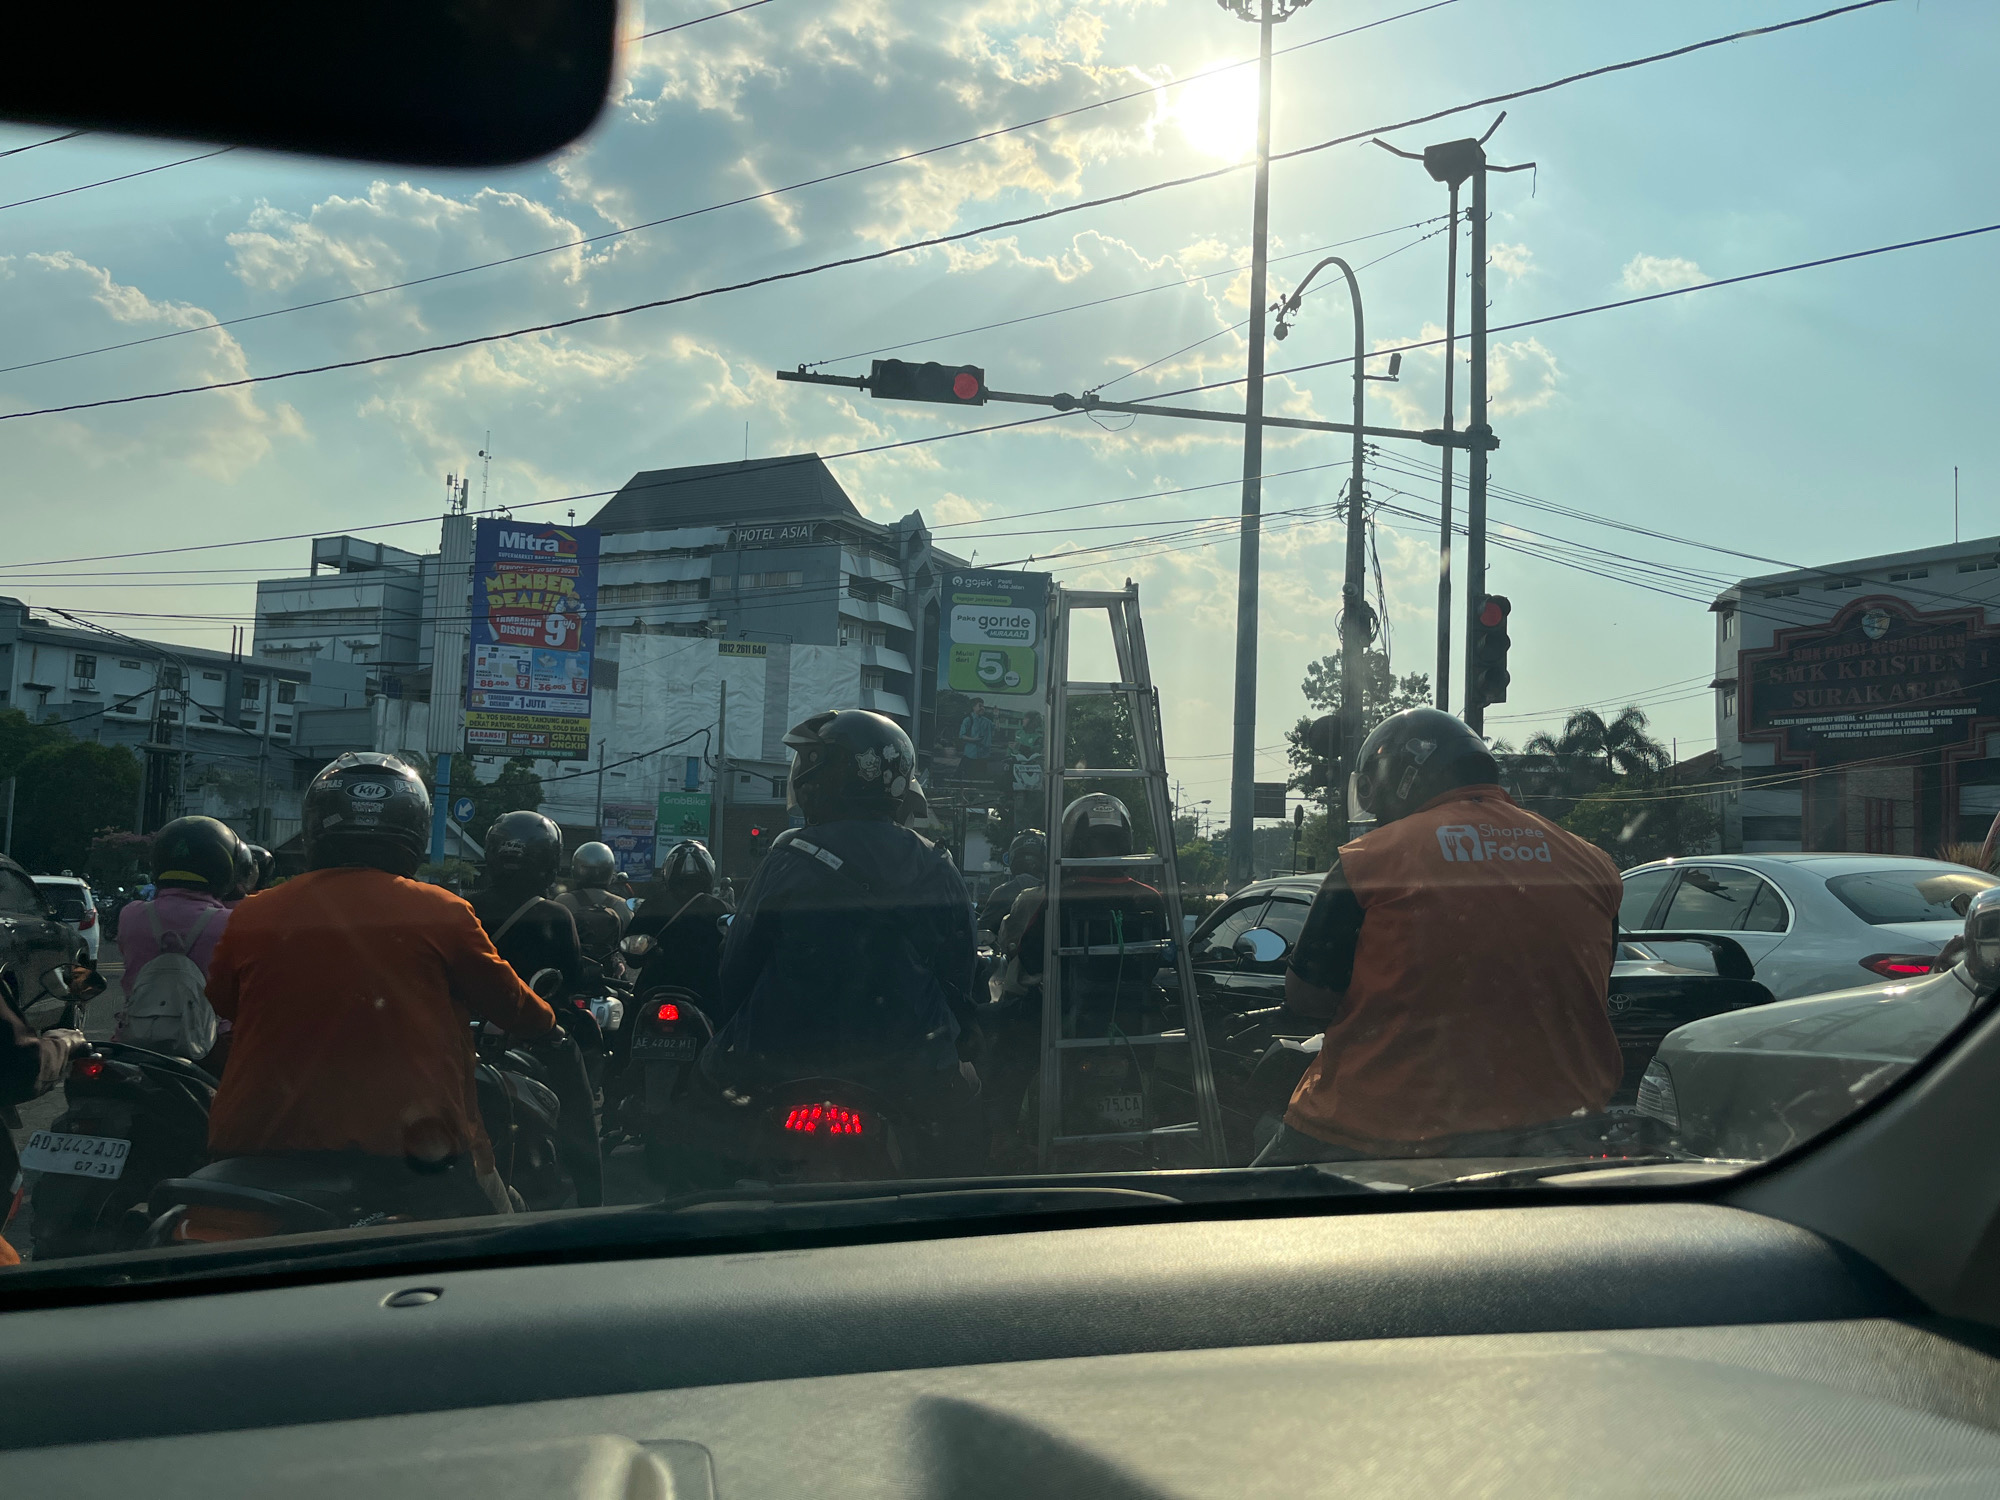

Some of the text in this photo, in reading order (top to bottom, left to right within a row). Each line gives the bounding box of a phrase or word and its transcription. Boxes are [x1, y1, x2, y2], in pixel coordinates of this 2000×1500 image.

[739, 525, 809, 541] HOTEL ASIA
[498, 552, 534, 560] SUPERMARKET
[485, 573, 575, 595] MEMBER
[964, 577, 993, 589] gojek
[496, 614, 542, 628] TAMBAHAN
[978, 615, 1031, 630] goride
[500, 625, 535, 637] DISKON
[719, 643, 735, 653] 0812
[752, 645, 767, 655] 640
[977, 651, 1004, 681] 5
[1769, 662, 1828, 684] SMK
[1838, 651, 1966, 679] KRISTEN
[1792, 679, 1966, 707] SURAKARTA
[526, 700, 547, 709] JUTA
[531, 717, 559, 725] TANJUNG
[1795, 716, 1833, 725] KOMUNIKASI
[1865, 712, 1893, 720] LAYANAN
[1893, 711, 1929, 719] KESEHATAN
[1936, 708, 1977, 716] PEMASARAN
[469, 720, 490, 728] DEKAT
[491, 722, 516, 730] PATUNG
[1812, 723, 1848, 731] MANAJEMEN
[1848, 721, 1894, 730] PERKANTORAN
[1901, 719, 1929, 727] LAYANAN
[531, 735, 546, 744] 2X
[552, 734, 586, 742] GRATIS
[550, 742, 587, 750] ONGKIR
[663, 796, 706, 805] GrabBike
[1478, 823, 1545, 840] Shopee
[1484, 841, 1552, 863] Food
[30, 1134, 126, 1159] AD 3442 AJD
